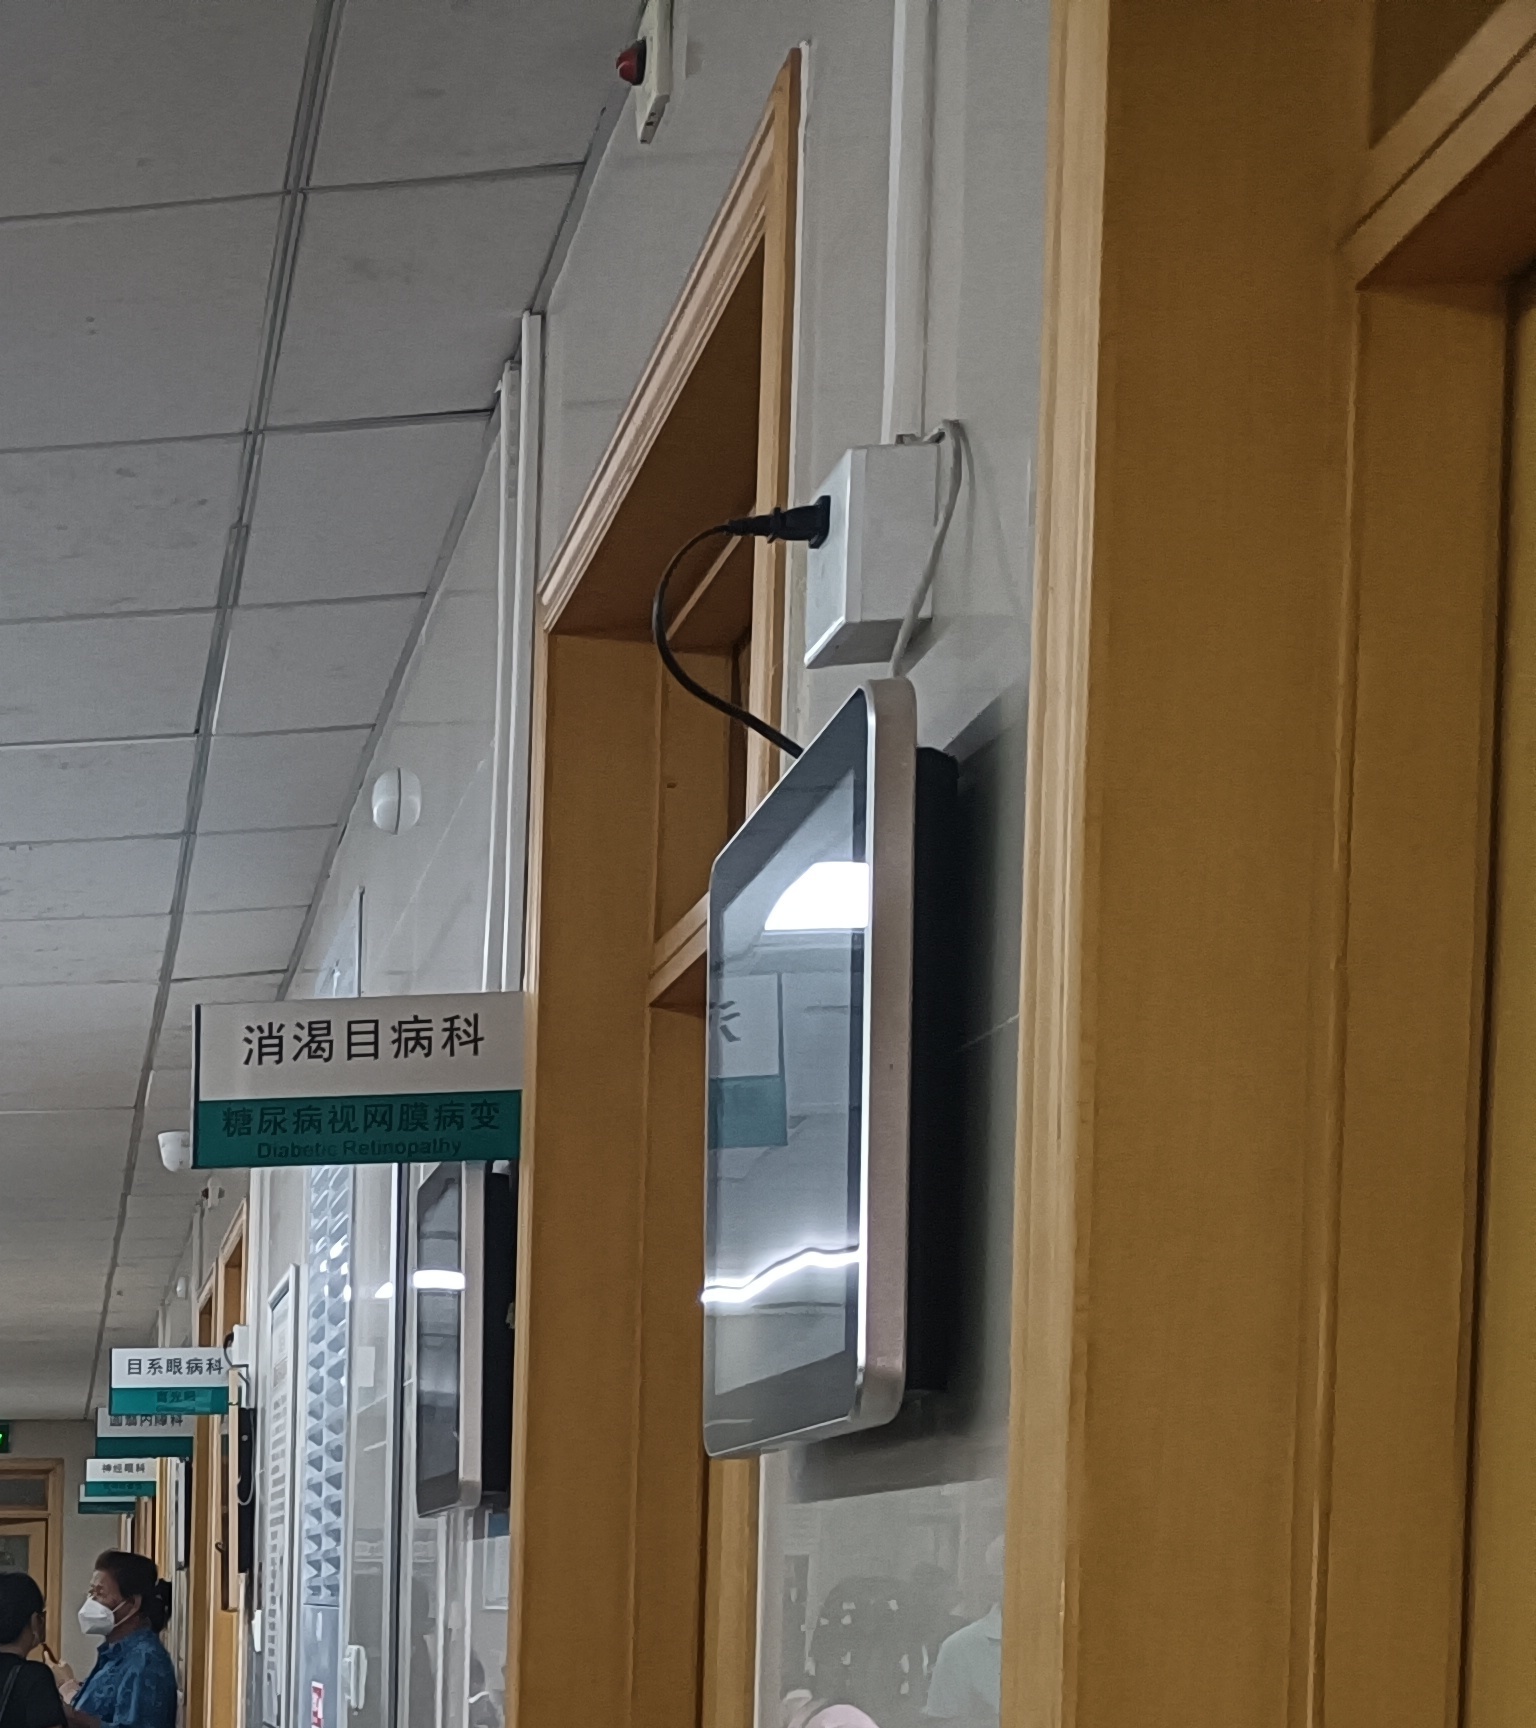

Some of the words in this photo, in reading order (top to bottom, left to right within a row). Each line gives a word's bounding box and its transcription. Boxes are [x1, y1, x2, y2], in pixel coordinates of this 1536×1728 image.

[241, 1012, 486, 1067] 消渴目病科
[222, 1099, 501, 1138] 糖尿病视网膜病变
[343, 1136, 462, 1158] Retinopathy
[127, 1357, 225, 1377] 目系眼病科
